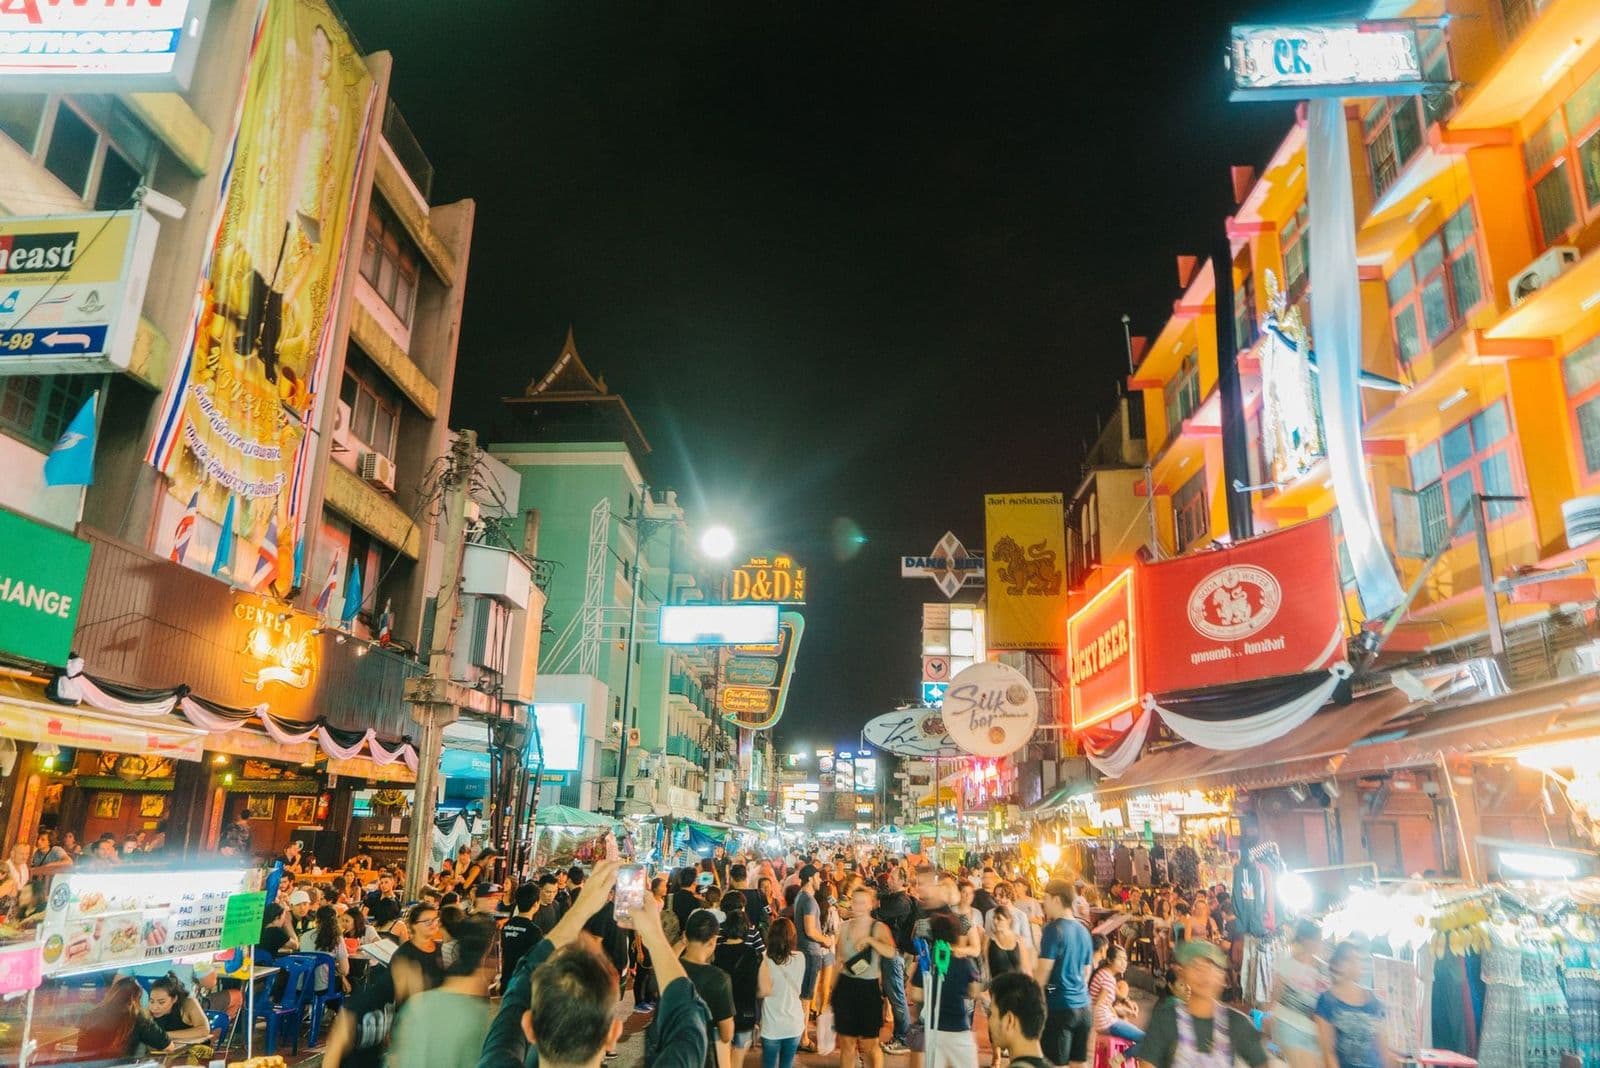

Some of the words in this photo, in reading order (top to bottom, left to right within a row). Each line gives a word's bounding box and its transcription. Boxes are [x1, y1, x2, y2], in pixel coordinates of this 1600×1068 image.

[731, 569, 791, 600] D&D
[794, 569, 804, 600] INN
[1098, 618, 1128, 670] BEER
[950, 684, 1007, 715] Silk
[180, 906, 192, 914] PAD
